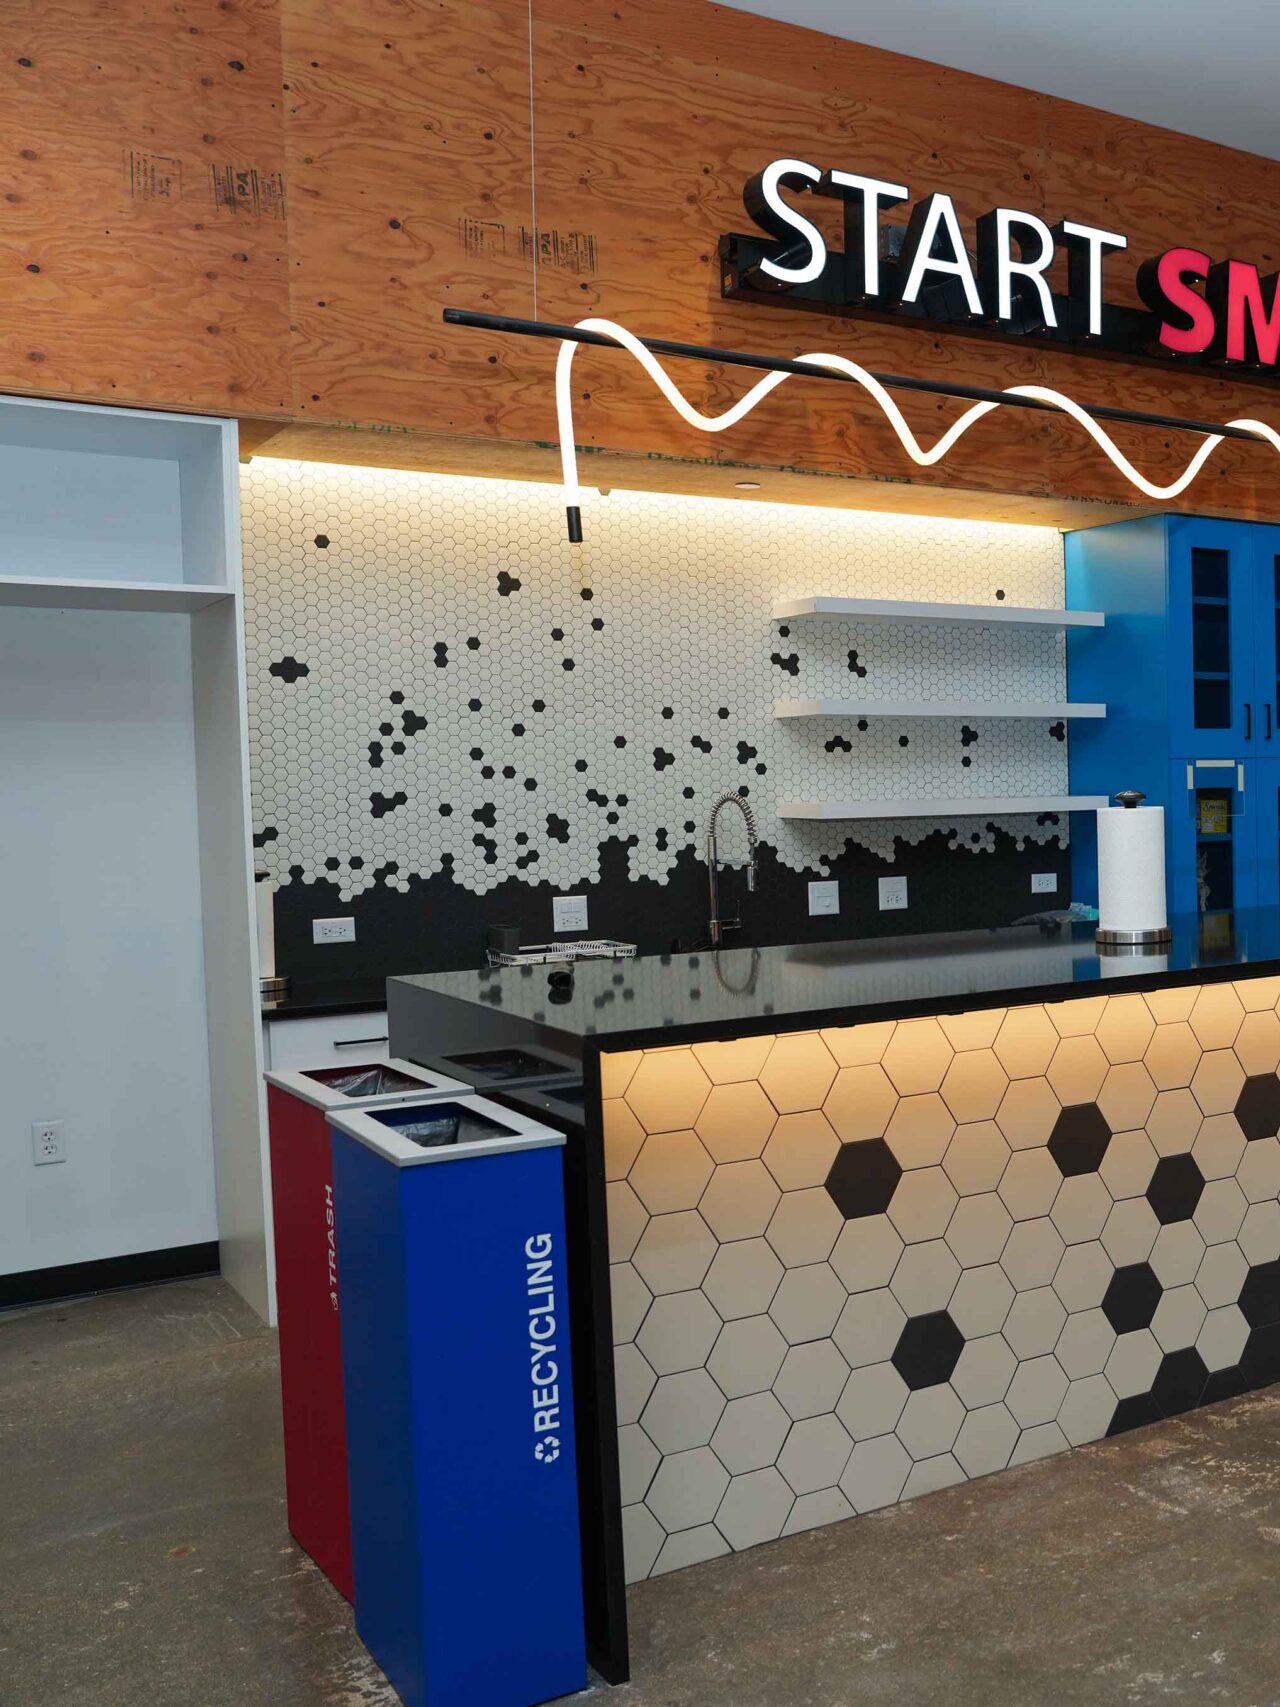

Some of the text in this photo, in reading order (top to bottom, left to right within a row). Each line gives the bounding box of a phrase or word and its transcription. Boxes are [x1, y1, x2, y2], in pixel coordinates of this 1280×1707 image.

[758, 157, 1128, 336] START
[325, 1184, 337, 1287] TRASH
[524, 1232, 561, 1433] RECYCLING
